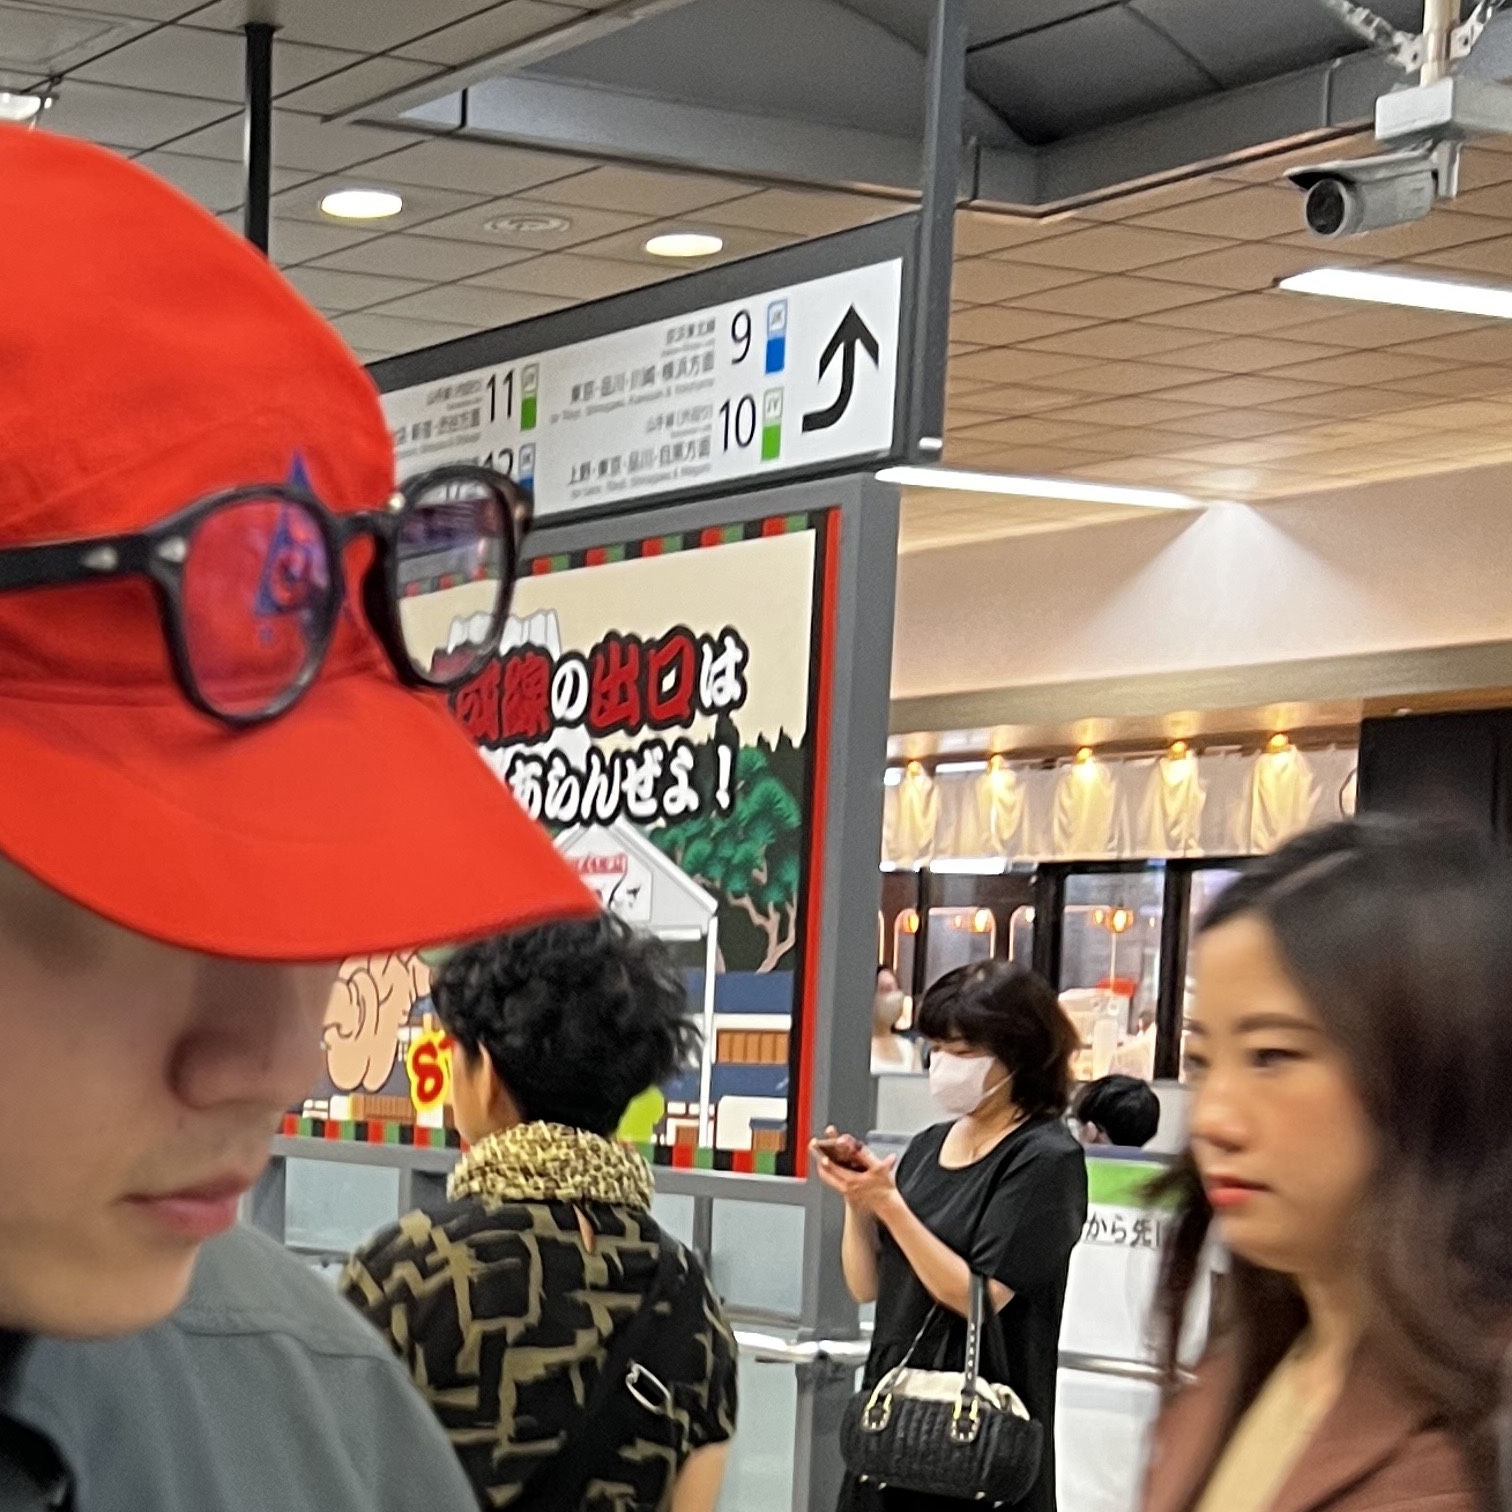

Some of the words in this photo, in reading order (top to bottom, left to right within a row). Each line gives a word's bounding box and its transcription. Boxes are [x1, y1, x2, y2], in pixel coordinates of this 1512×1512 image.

[730, 309, 752, 366] 9
[486, 368, 515, 424] 11
[718, 392, 757, 454] 10
